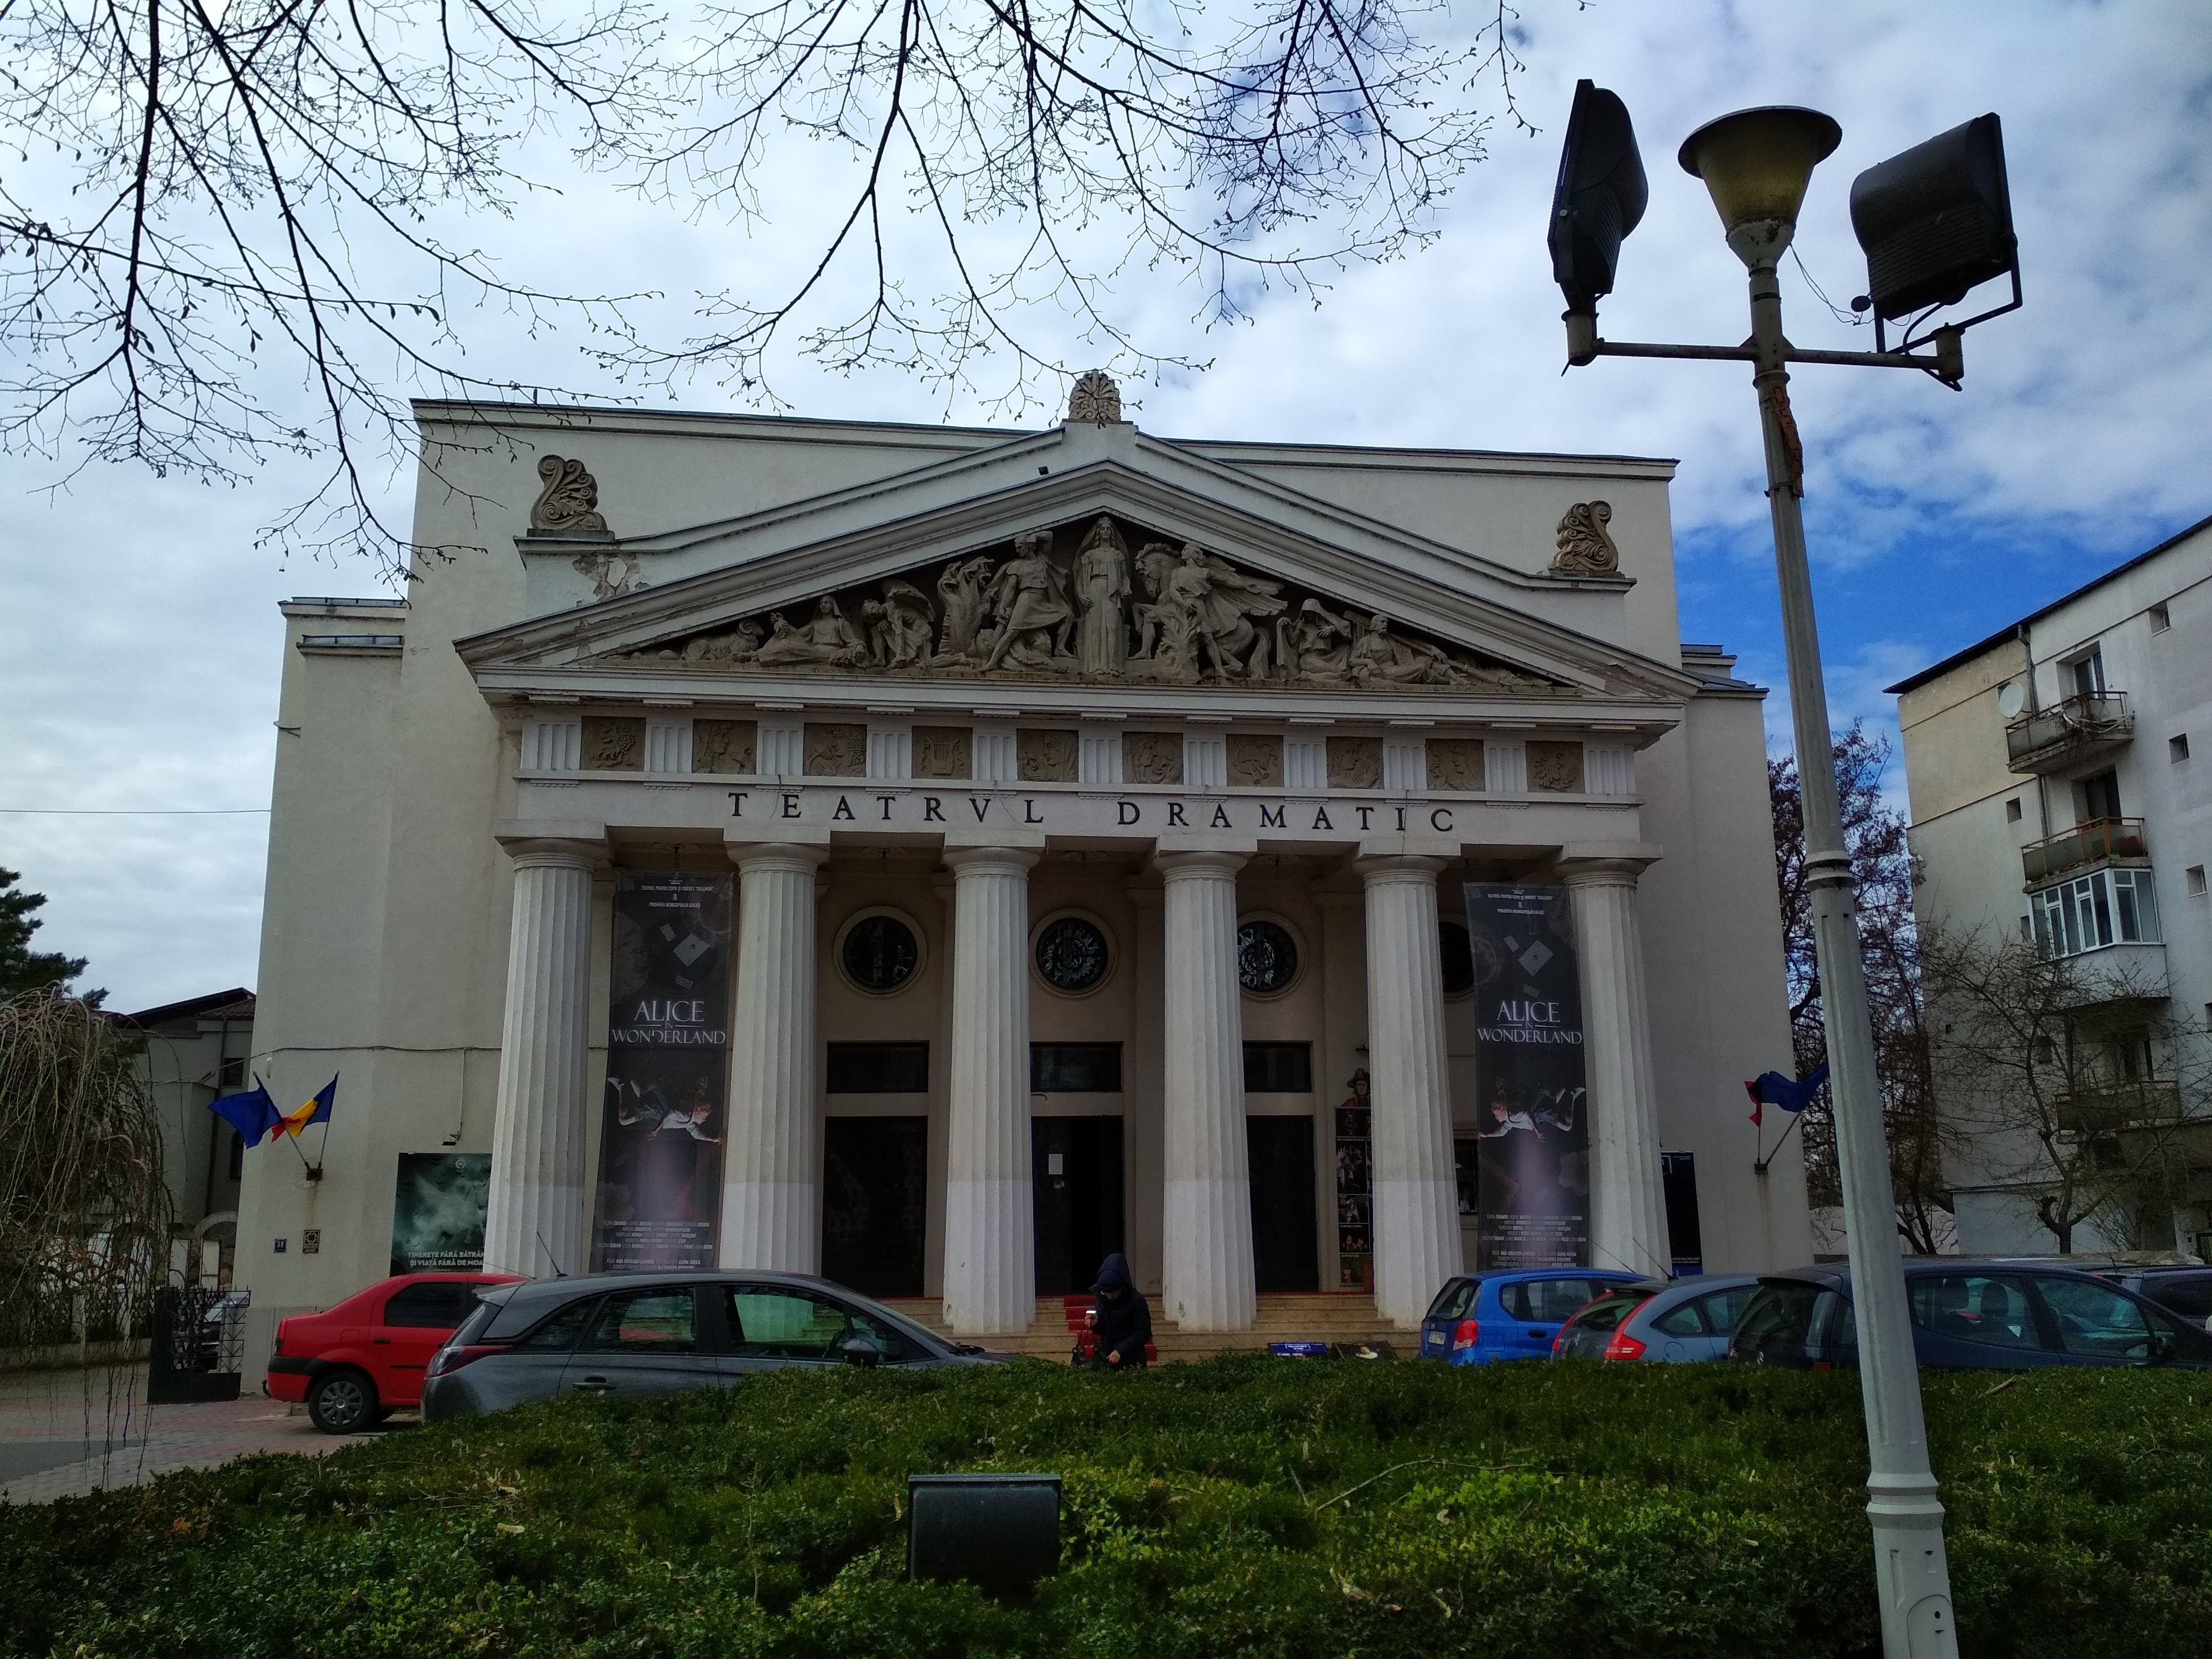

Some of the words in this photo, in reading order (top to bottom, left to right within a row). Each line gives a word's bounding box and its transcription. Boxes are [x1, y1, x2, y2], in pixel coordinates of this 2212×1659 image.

[728, 792, 1044, 823] TEATRVL
[1117, 801, 1453, 832] DRAMATIC
[633, 1000, 704, 1022] ALICE
[1496, 1001, 1561, 1023] ALICE
[612, 1029, 726, 1044] WONDERLAND
[1477, 1028, 1582, 1044] WONDERLAND
[410, 1260, 416, 1268] ȘI
[417, 1259, 437, 1268] VIAȚĂ
